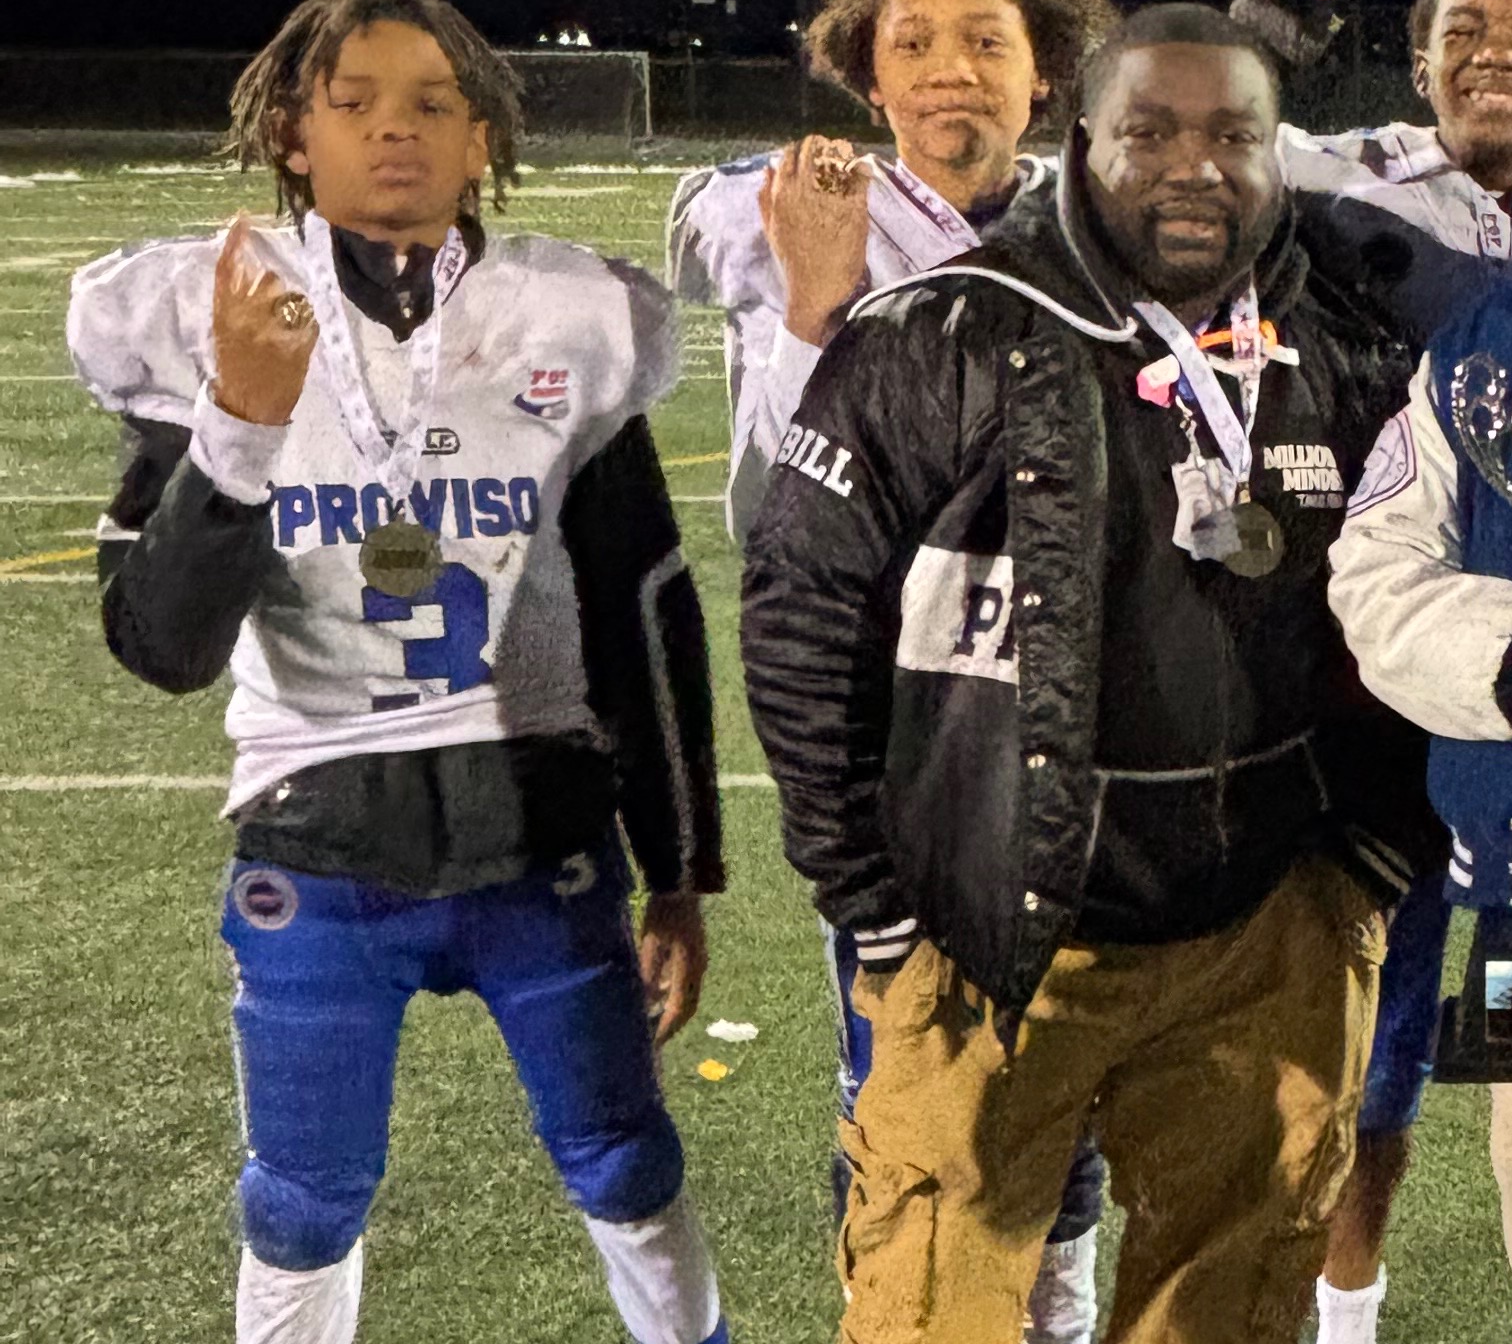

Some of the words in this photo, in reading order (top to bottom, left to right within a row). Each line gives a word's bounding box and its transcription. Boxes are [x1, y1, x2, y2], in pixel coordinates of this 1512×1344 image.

[776, 423, 854, 498] BILL
[1282, 468, 1344, 492] MINDS
[274, 476, 541, 548] PROVISO
